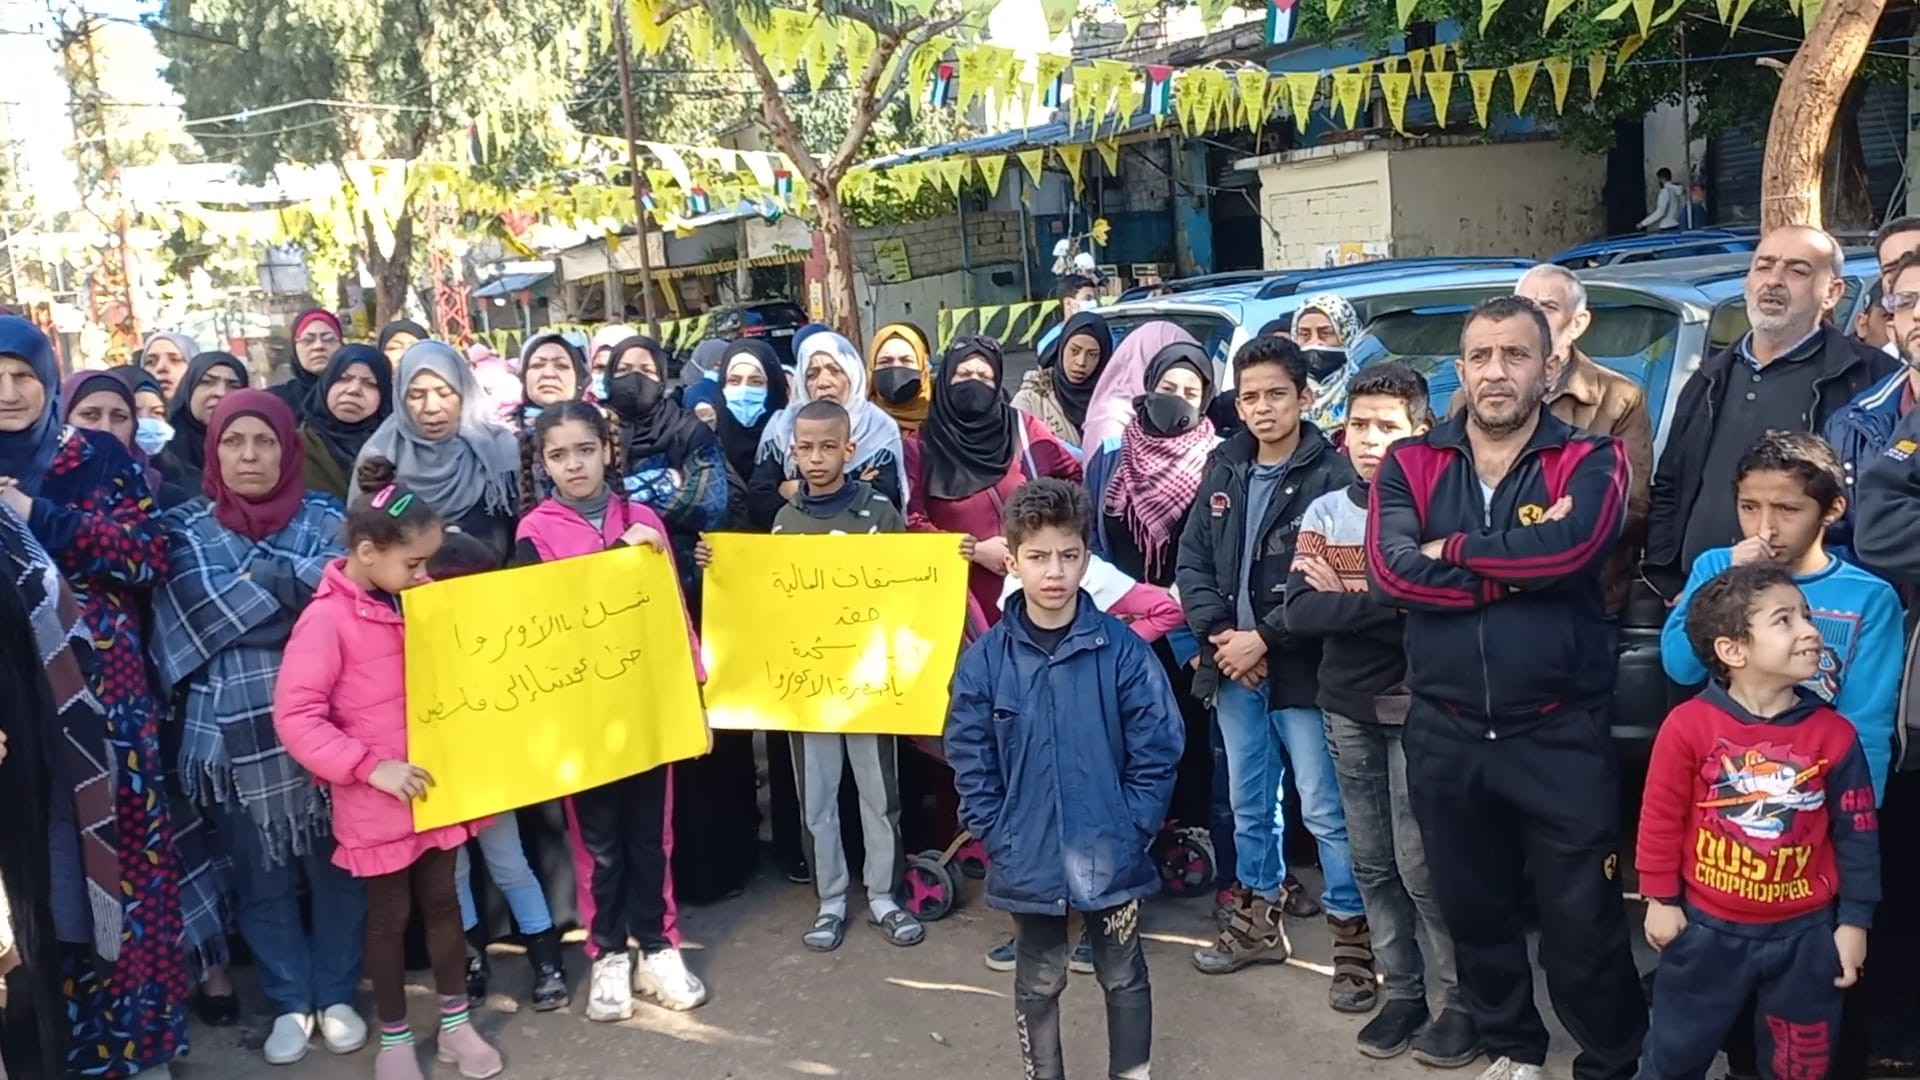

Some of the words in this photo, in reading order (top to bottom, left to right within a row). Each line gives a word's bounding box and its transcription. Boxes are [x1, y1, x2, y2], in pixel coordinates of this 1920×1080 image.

[771, 561, 825, 599] المالية
[1696, 827, 1812, 882] DUSTY
[1695, 861, 1814, 903] CROPHOPPER
